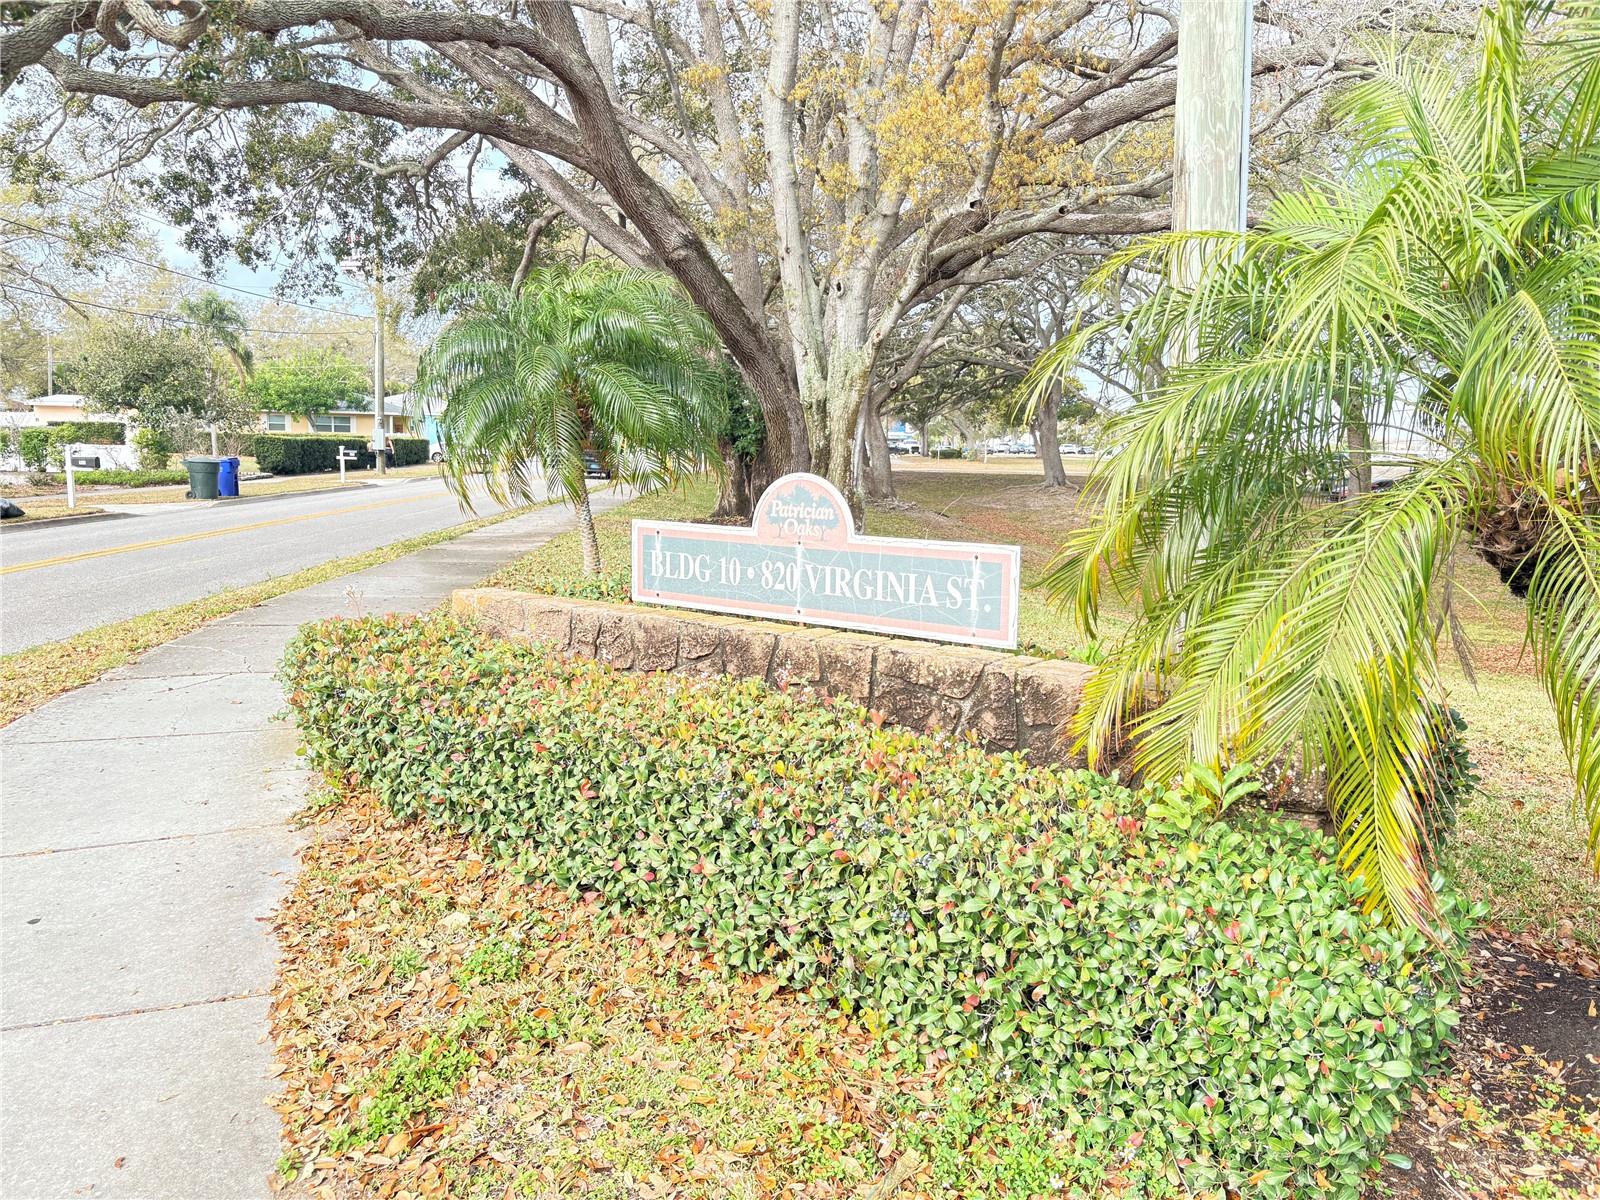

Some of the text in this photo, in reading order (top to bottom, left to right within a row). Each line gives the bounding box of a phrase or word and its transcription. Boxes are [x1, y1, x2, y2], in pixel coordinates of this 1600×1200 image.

[771, 500, 834, 520] Patrician
[784, 518, 820, 536] Oaks
[651, 550, 992, 613] BLDG 10 820 VIRGINIA ST.
